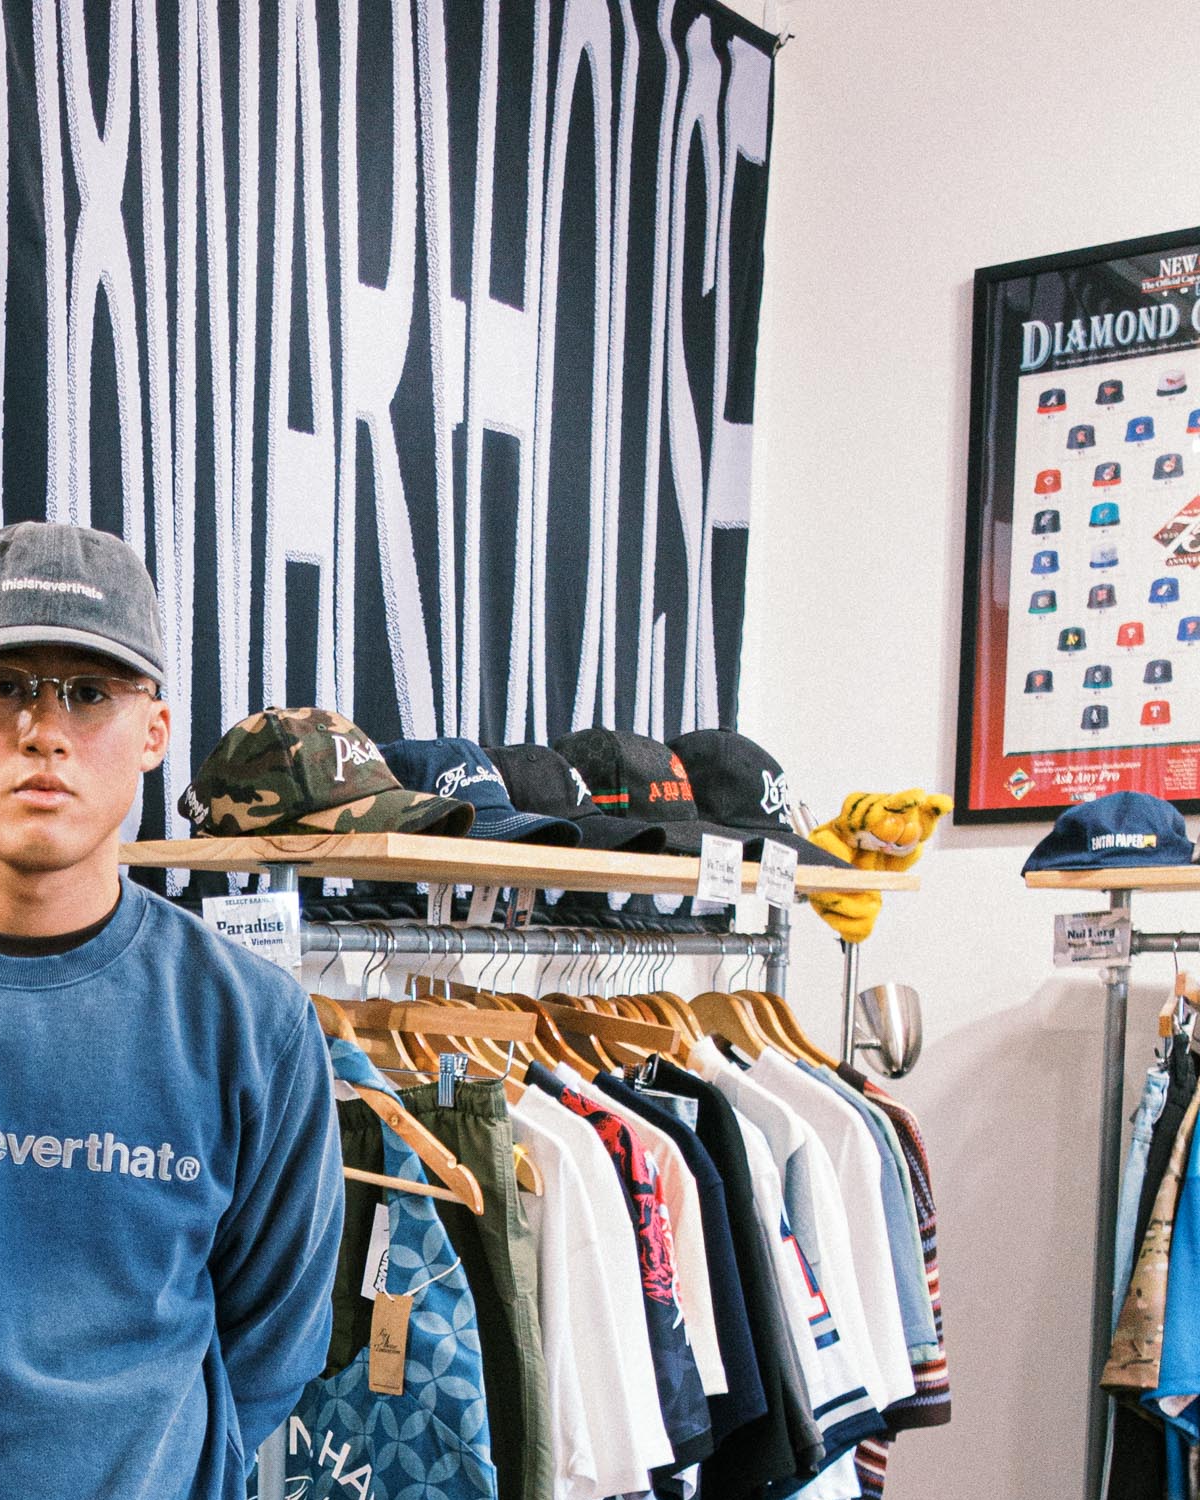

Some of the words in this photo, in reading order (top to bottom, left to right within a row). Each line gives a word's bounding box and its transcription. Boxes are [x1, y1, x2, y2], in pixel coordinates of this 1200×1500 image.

[1159, 253, 1199, 278] NEW
[1020, 303, 1181, 372] DIAMOND
[216, 918, 284, 935] Paradise
